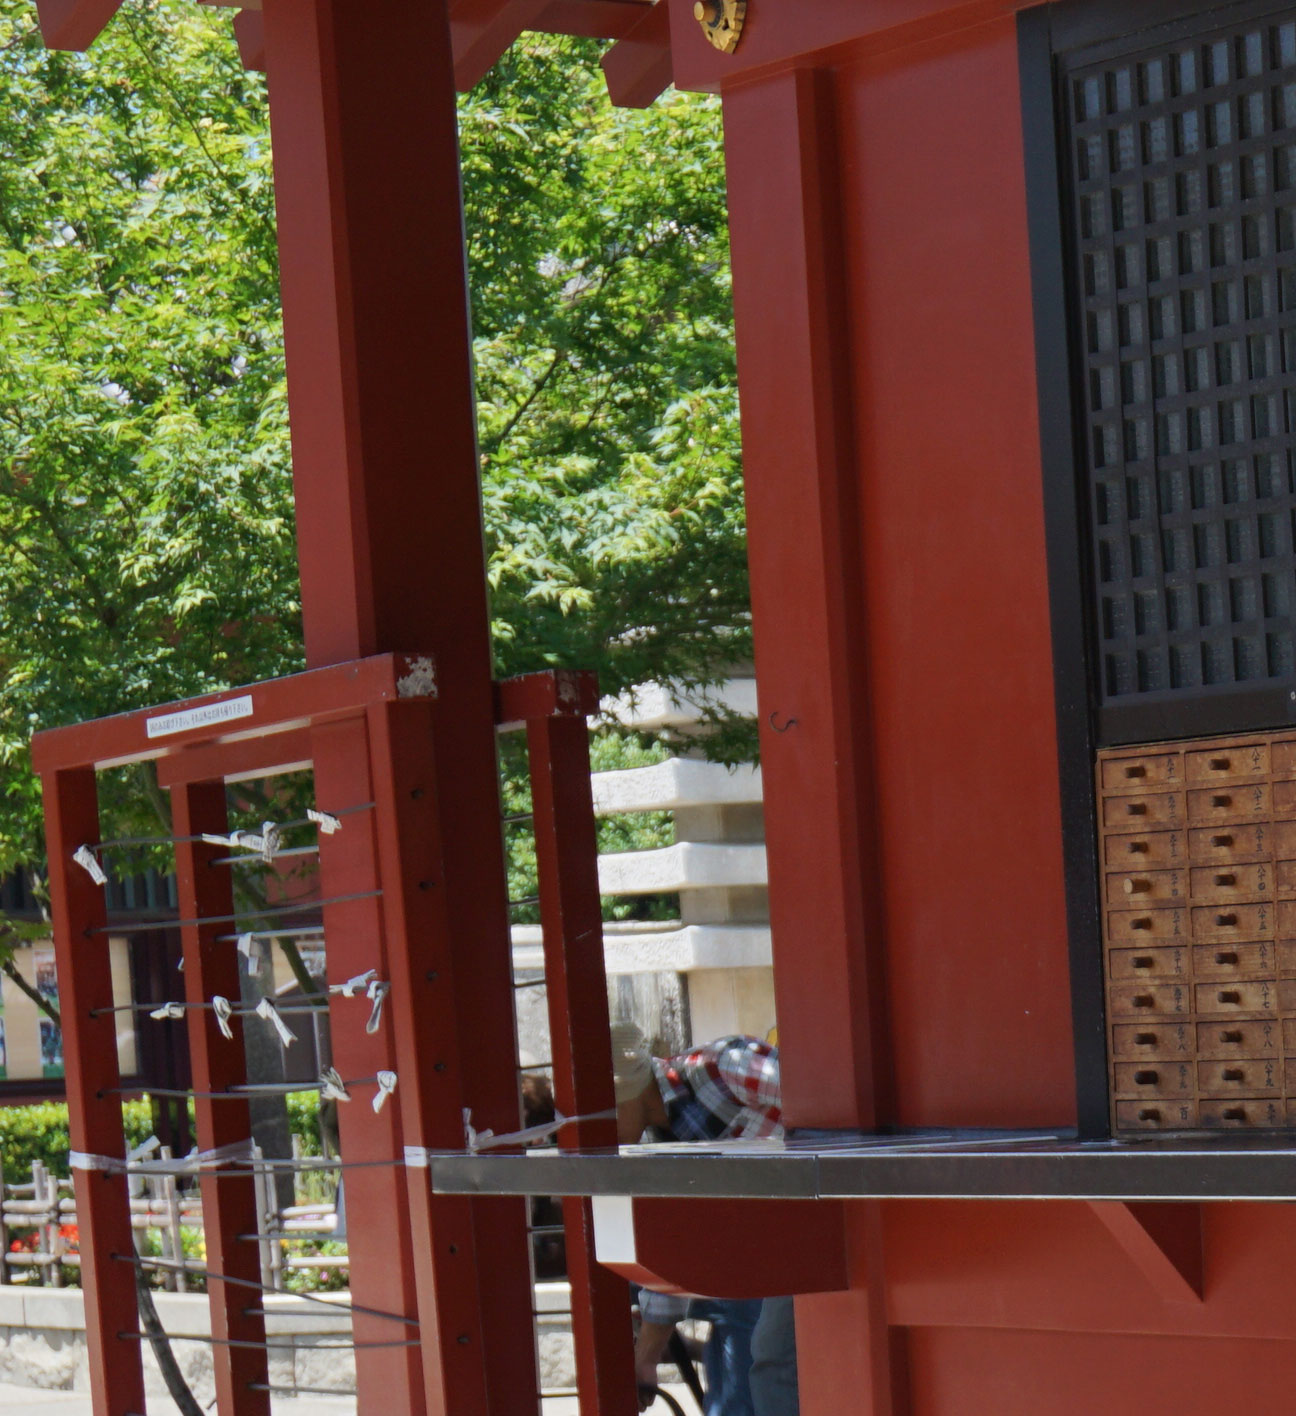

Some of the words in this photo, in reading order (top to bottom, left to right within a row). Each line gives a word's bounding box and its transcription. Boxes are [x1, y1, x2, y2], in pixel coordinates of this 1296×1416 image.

[1166, 755, 1175, 779] 九十一
[1252, 748, 1261, 770] 八十一
[1254, 787, 1262, 810] 八十二
[1257, 867, 1265, 891] 八十四
[1173, 910, 1181, 935] 九十五
[1258, 905, 1267, 930] 八十五
[1261, 983, 1270, 1009] 八十七
[1264, 1023, 1272, 1047] 八十八
[1265, 1061, 1273, 1087] 八十九
[1179, 1106, 1188, 1120] 百
